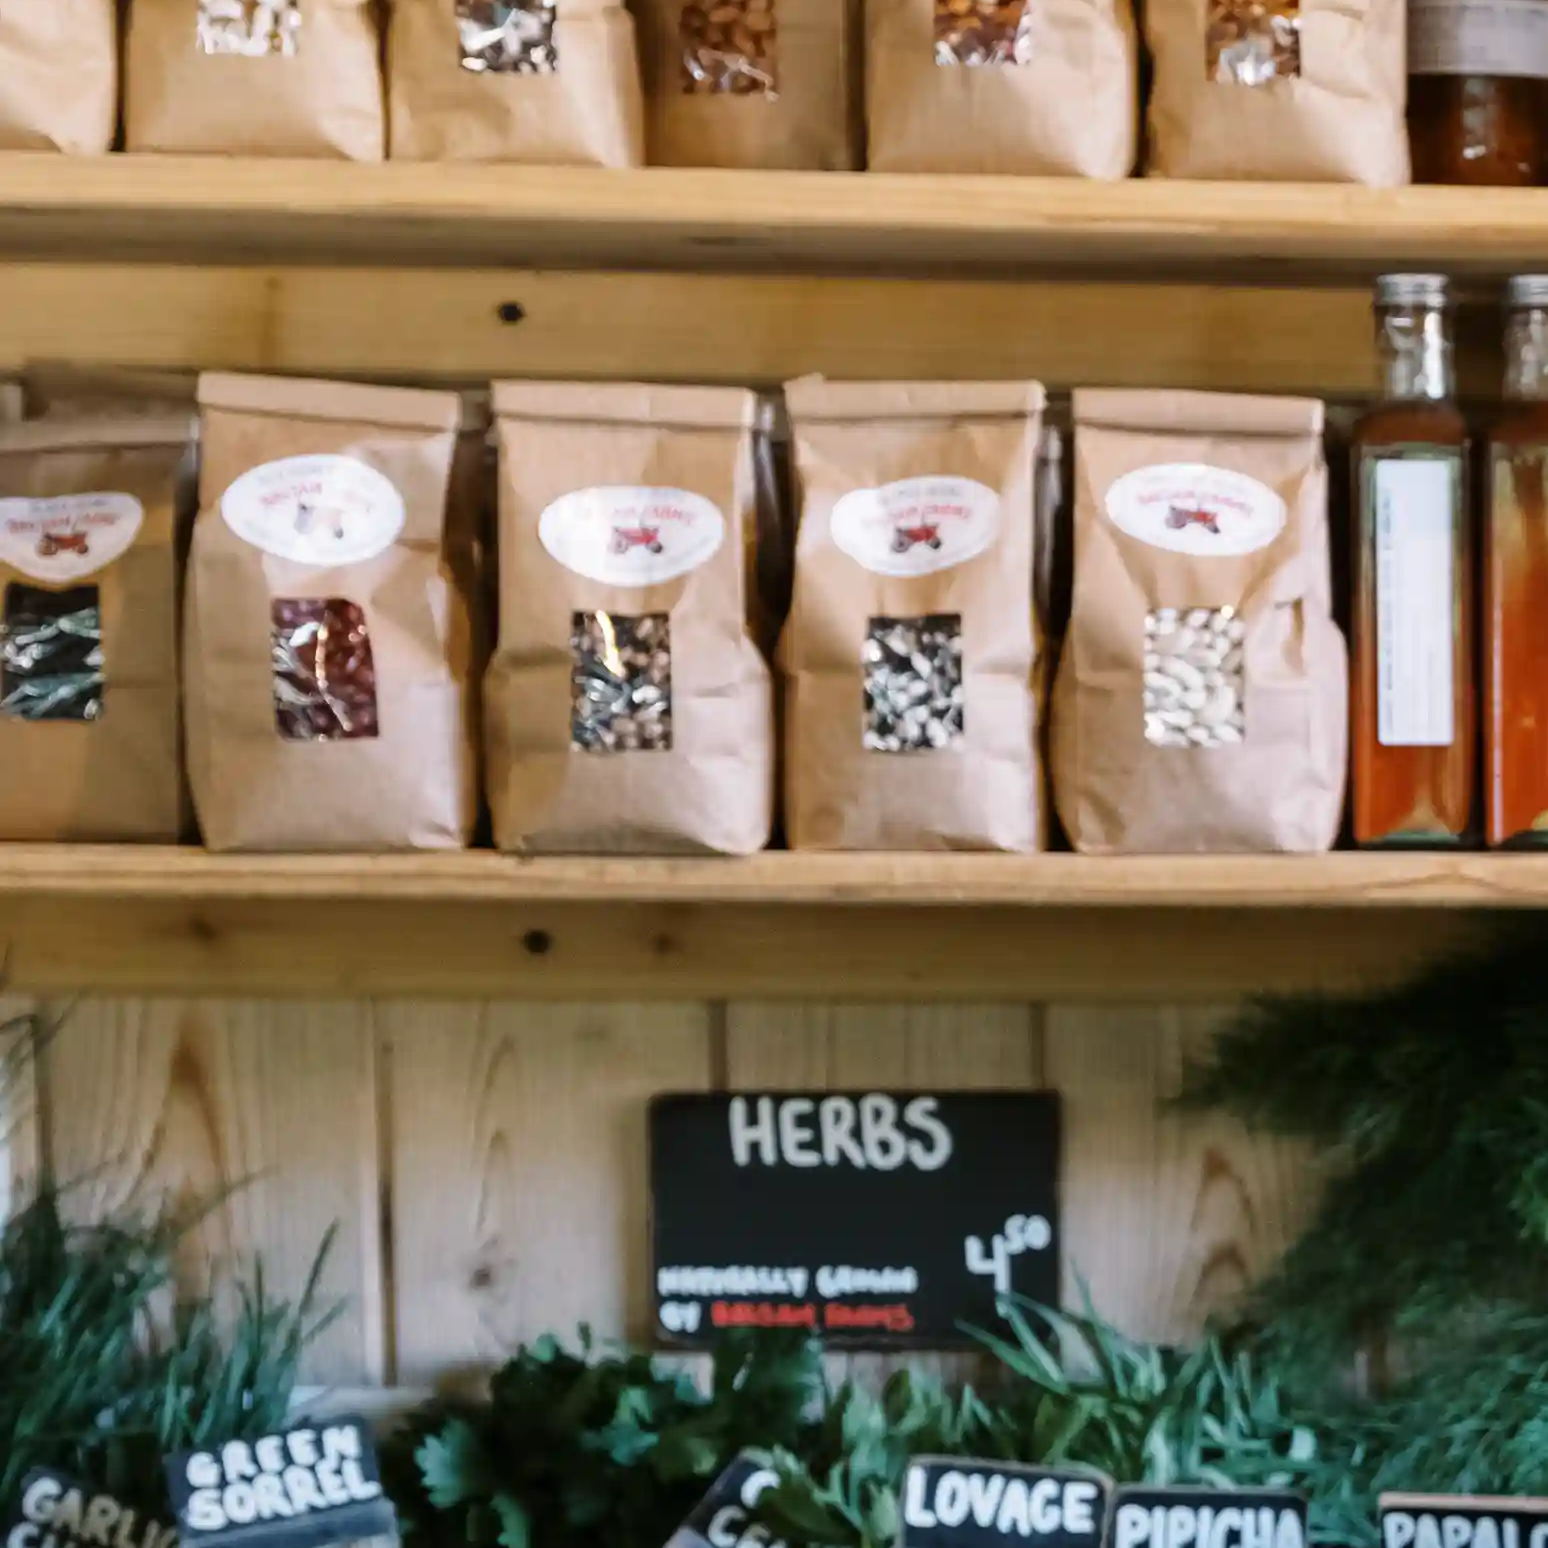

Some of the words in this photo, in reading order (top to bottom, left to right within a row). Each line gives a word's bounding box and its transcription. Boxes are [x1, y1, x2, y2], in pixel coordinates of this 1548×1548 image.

[727, 1092, 953, 1170] HERBS
[186, 1425, 363, 1490] GREEN
[186, 1460, 381, 1532] SORREL
[904, 1472, 1098, 1535] LOVAGE
